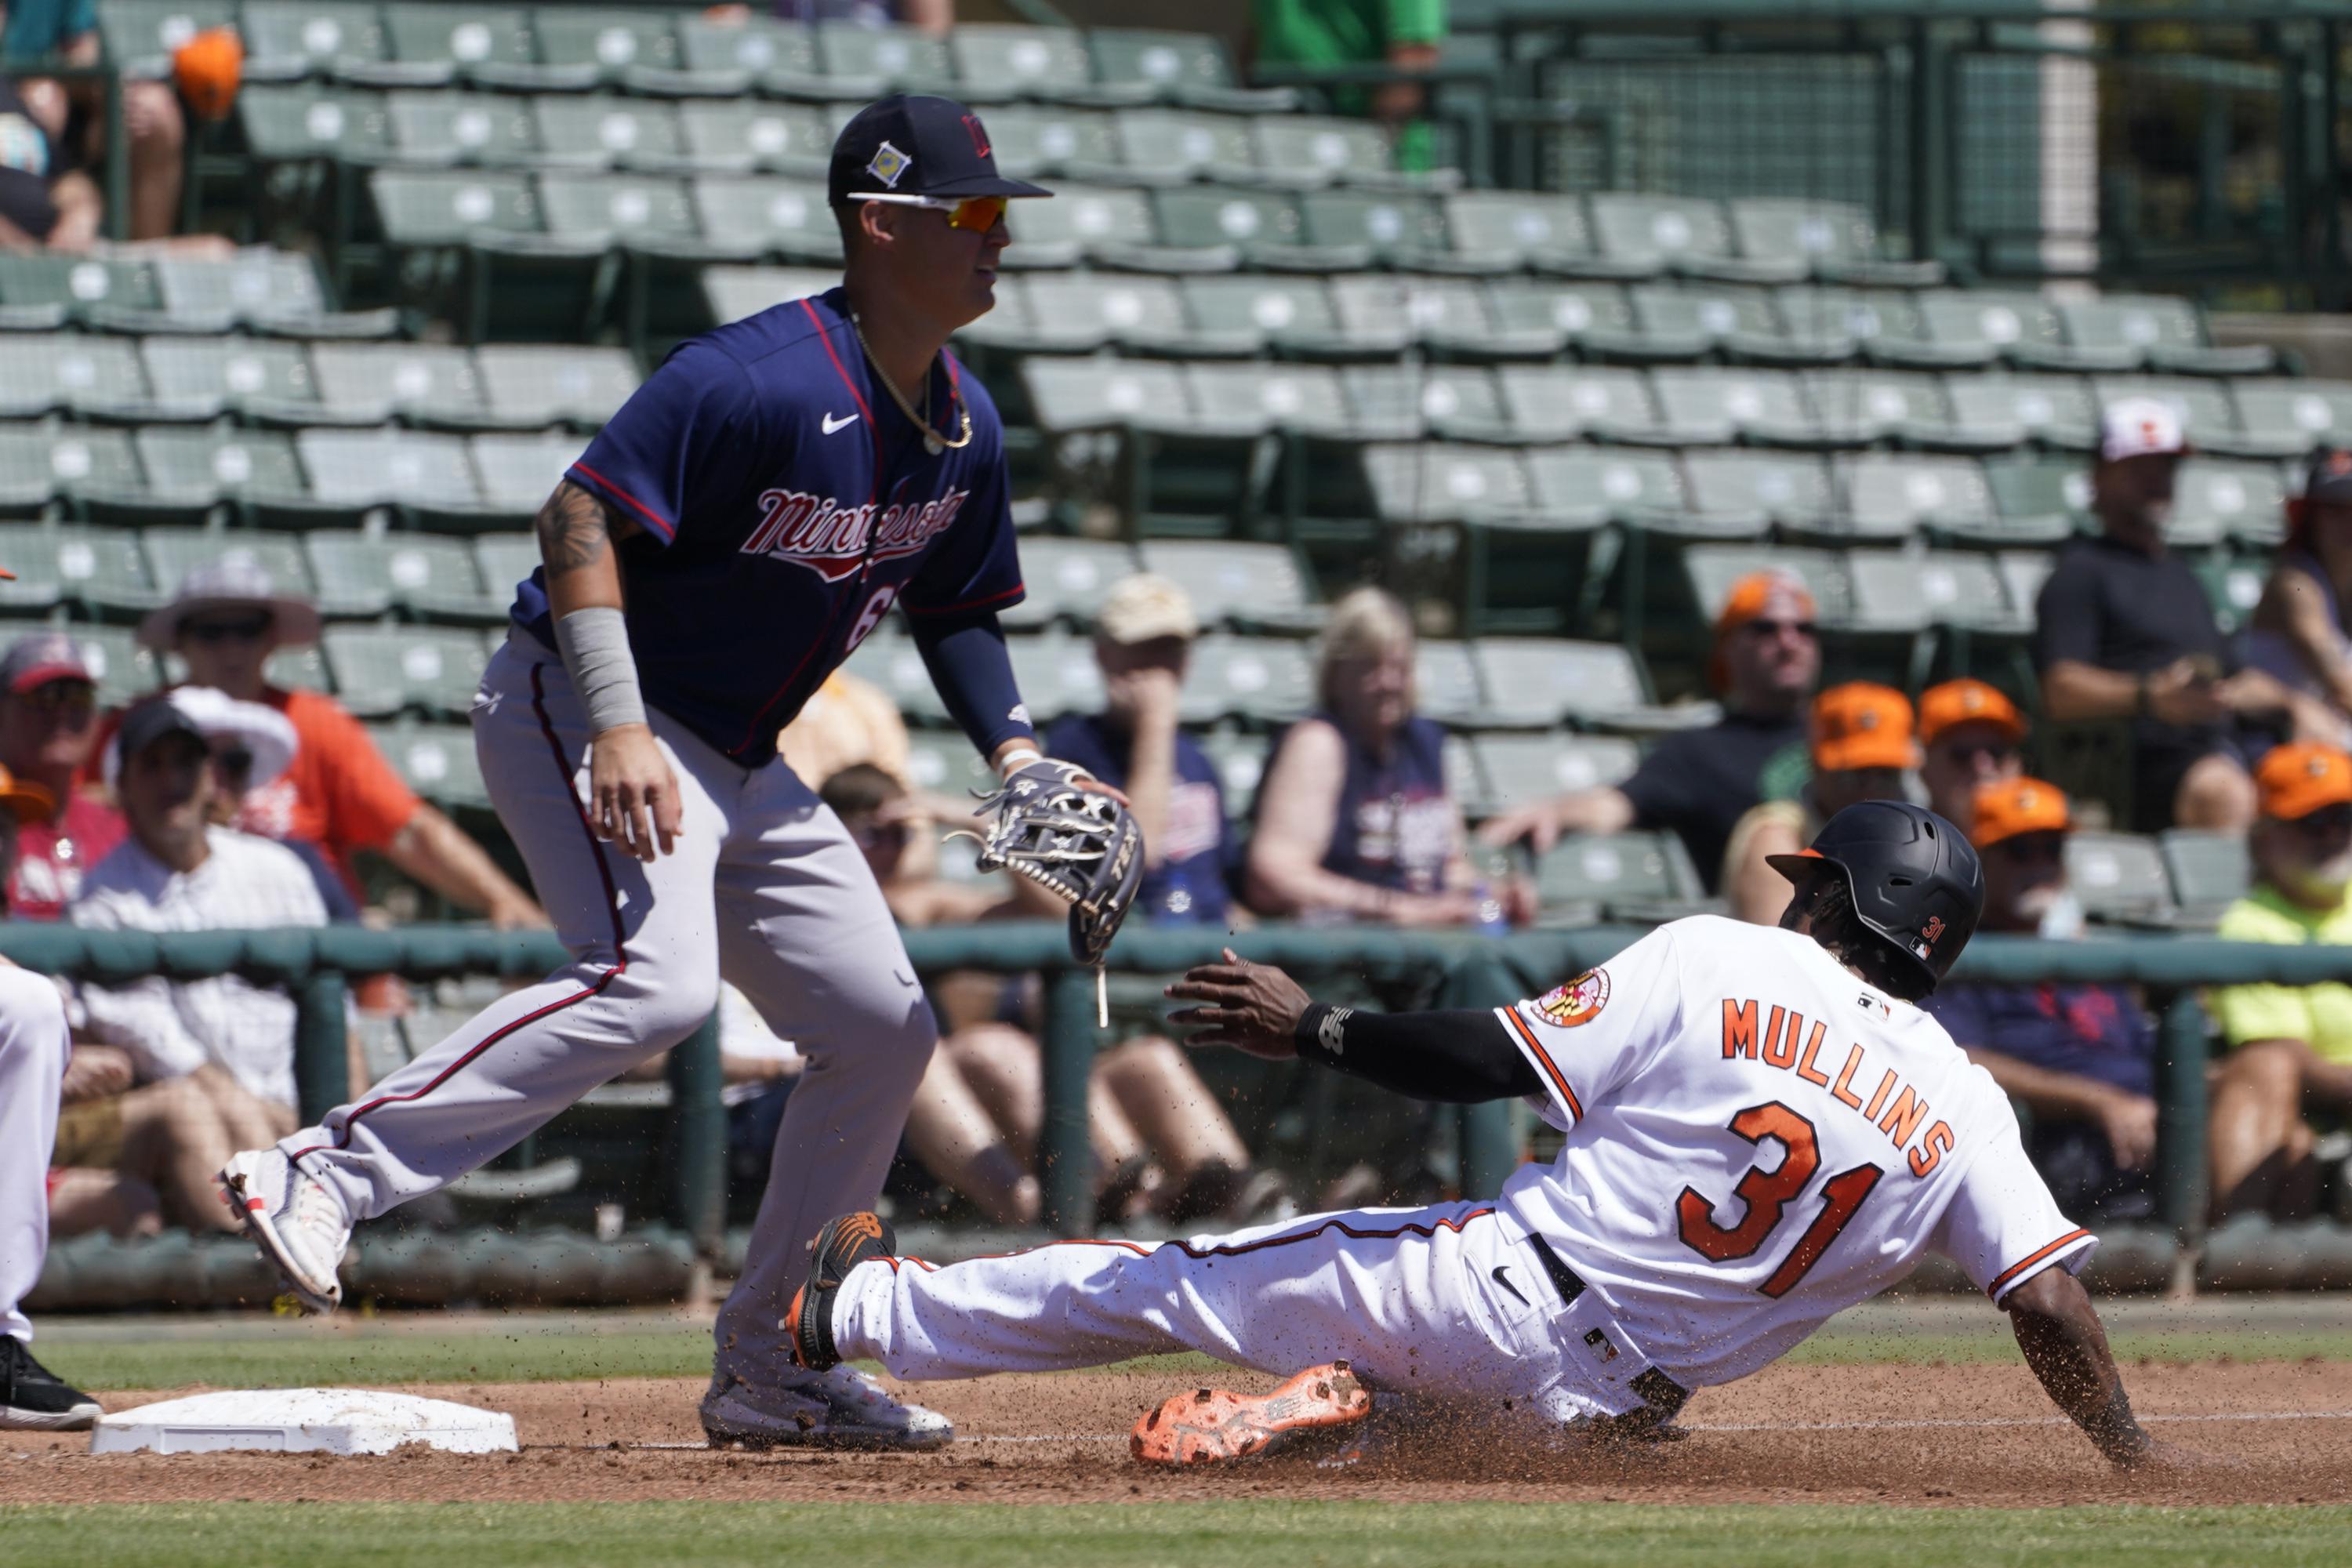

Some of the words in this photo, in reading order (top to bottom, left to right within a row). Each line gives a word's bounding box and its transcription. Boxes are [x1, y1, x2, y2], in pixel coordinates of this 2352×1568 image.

[1922, 916, 1946, 944] 31
[1722, 998, 1955, 1178] MULLINS
[1675, 1100, 1886, 1299] 31
